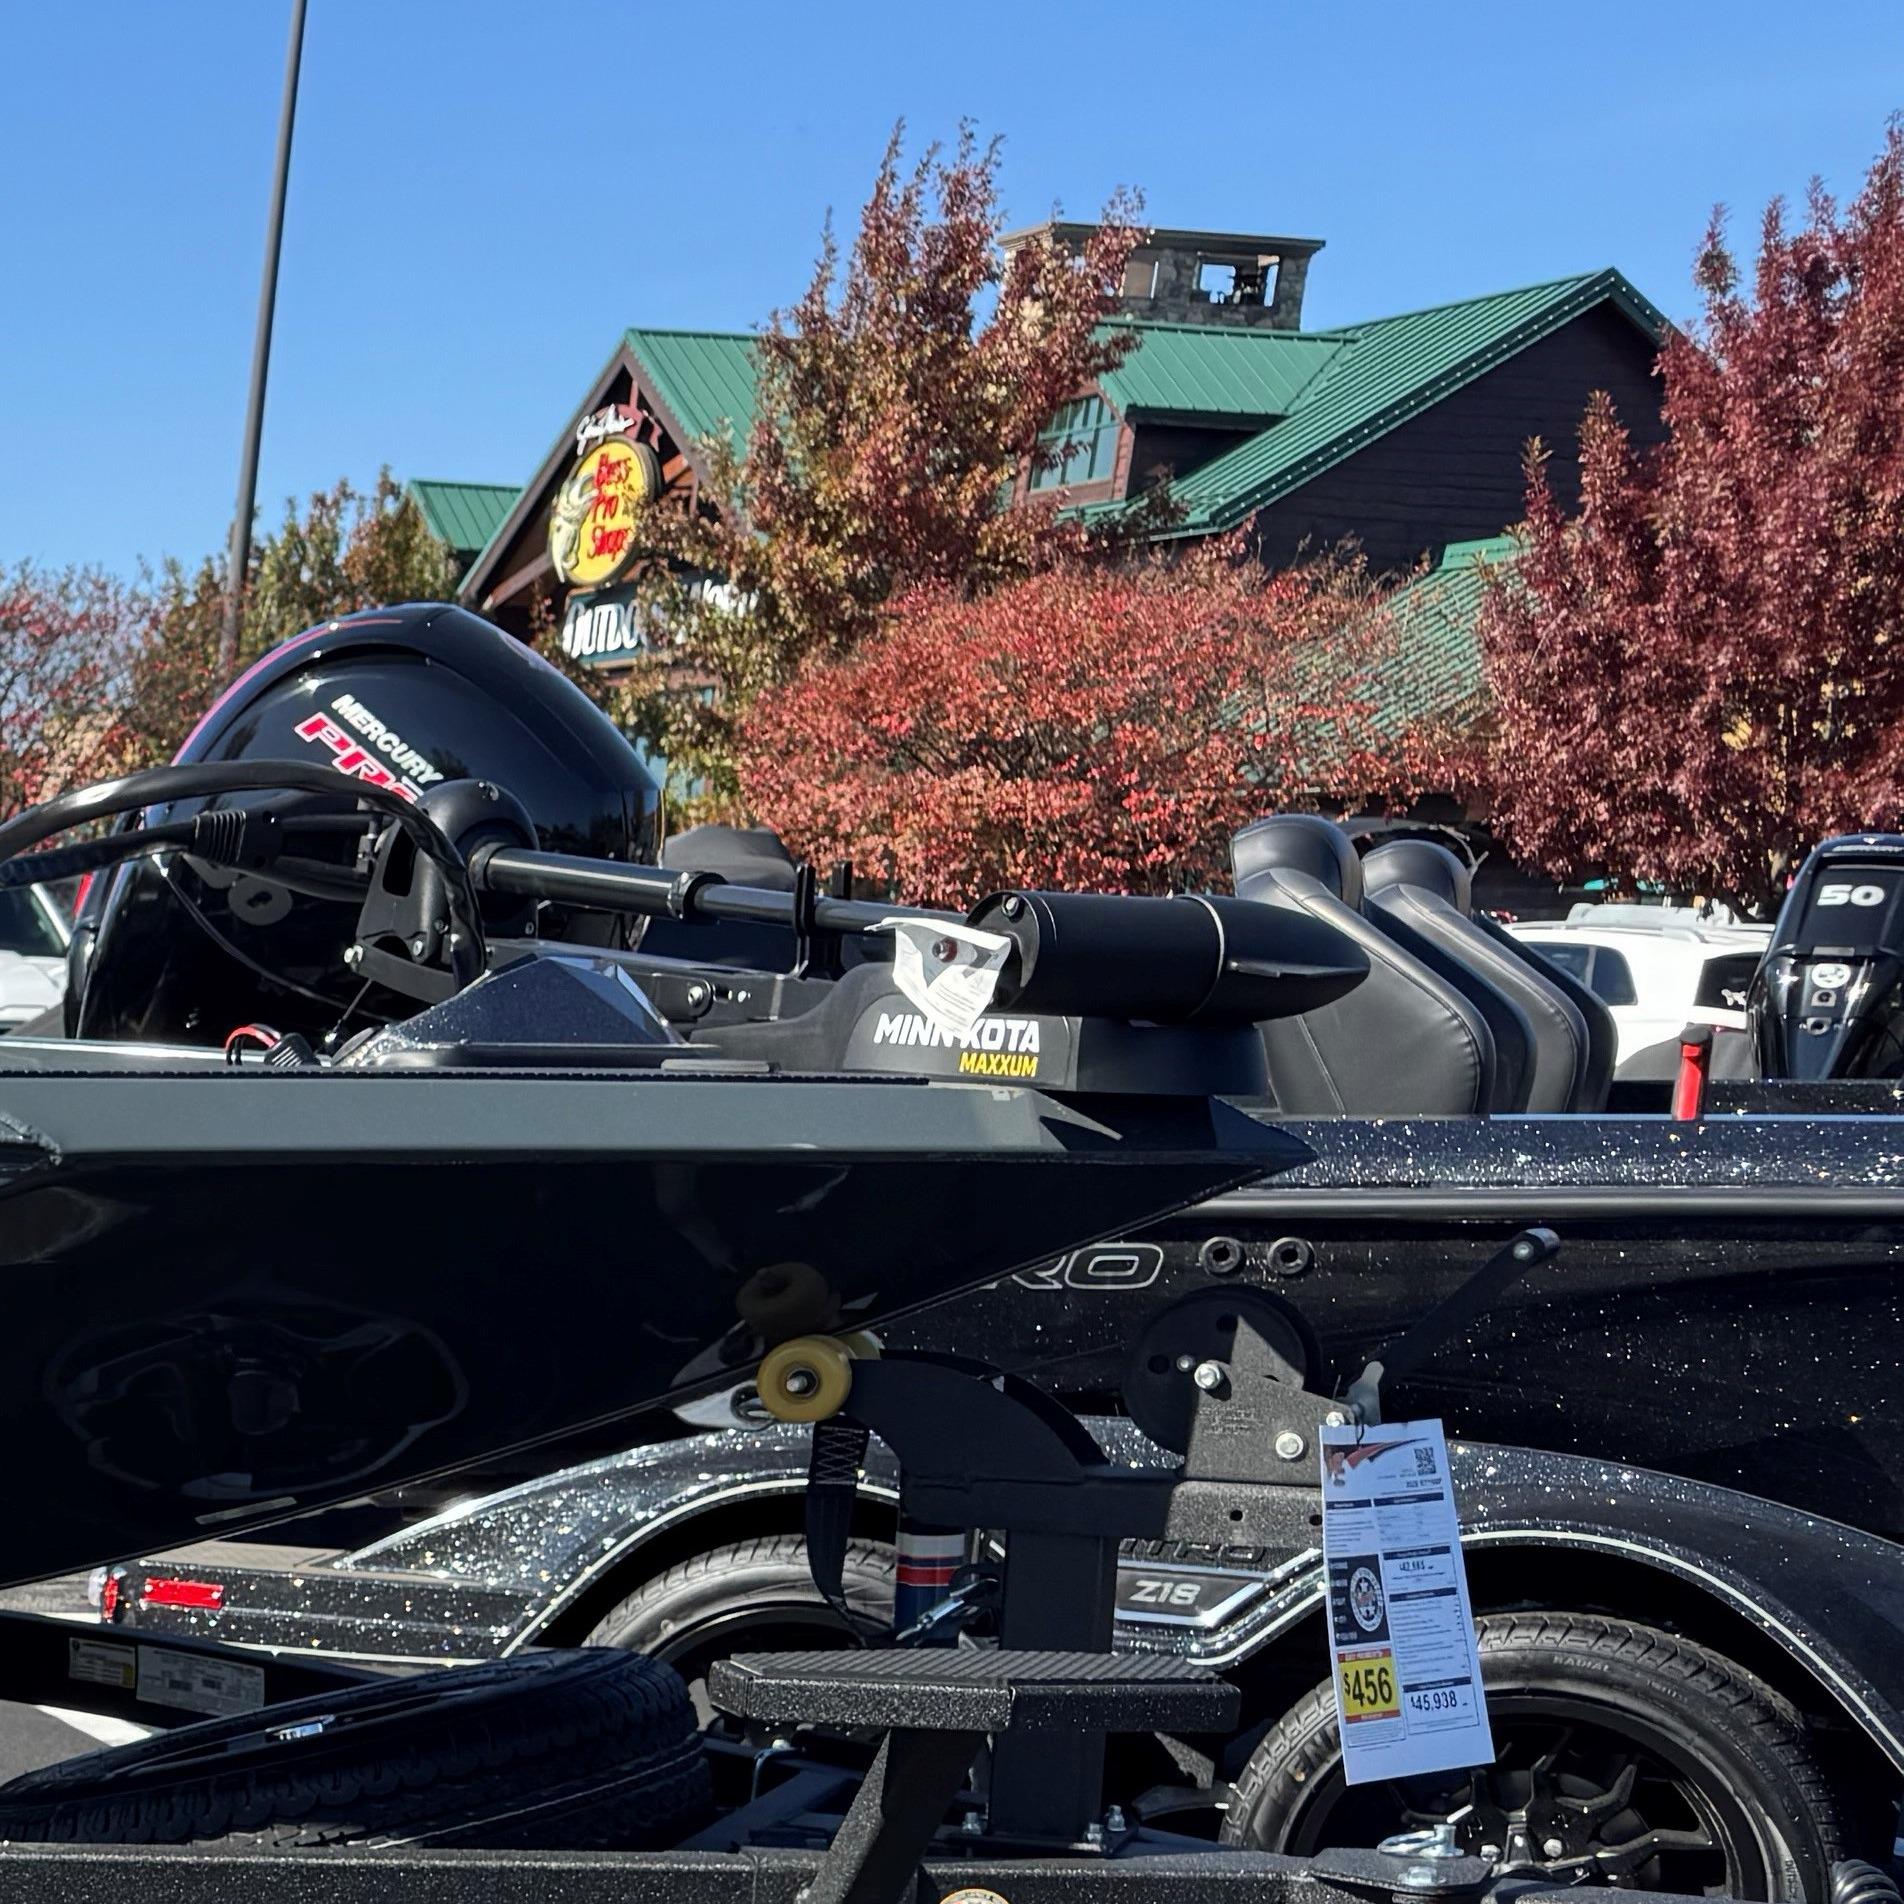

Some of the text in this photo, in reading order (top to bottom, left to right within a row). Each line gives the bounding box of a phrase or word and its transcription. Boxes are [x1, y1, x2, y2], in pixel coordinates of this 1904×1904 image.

[330, 693, 444, 784] MERCURY
[1817, 884, 1885, 907] 50
[958, 1051, 1039, 1078] MAXXUM
[1129, 1580, 1201, 1605] Z18
[1344, 1666, 1393, 1708] $456
